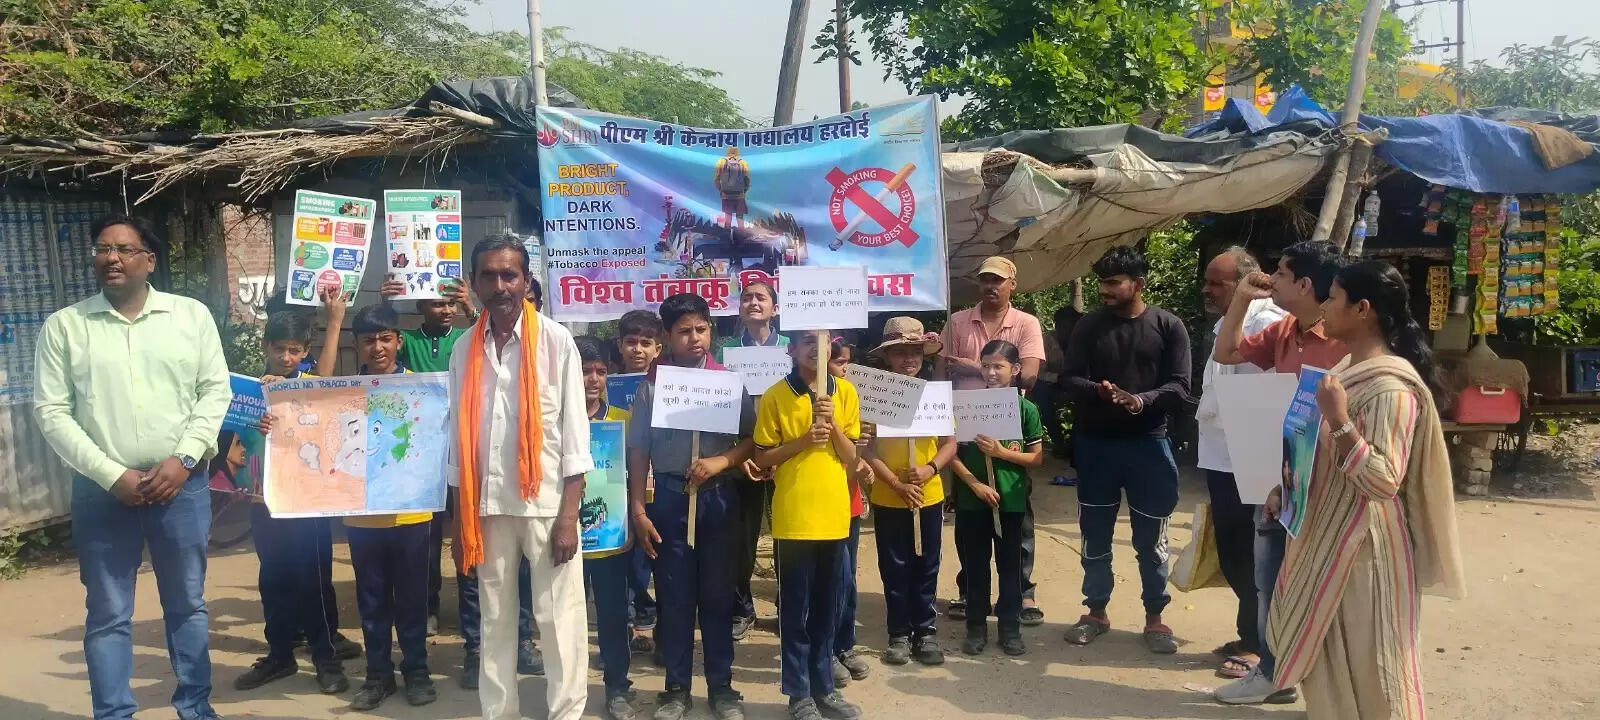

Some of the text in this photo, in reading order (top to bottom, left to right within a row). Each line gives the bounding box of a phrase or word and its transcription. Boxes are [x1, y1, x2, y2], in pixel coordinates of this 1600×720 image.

[600, 121, 648, 144] पीएम
[652, 124, 676, 146] श्री
[819, 112, 871, 142] हरदोई
[558, 163, 618, 178] BRIGHT
[548, 181, 630, 197] PRODUCT,
[832, 170, 877, 215] NOT SMOKING
[567, 200, 613, 214] DARK
[857, 188, 913, 245] YOUR BEST CHOICE!
[545, 217, 641, 232] NTENTIONS.
[547, 246, 646, 257] Unmask the appeal
[547, 258, 646, 269] #Tobacco Exposed
[560, 276, 634, 305] विश्व
[868, 273, 915, 297] वस
[268, 383, 299, 392] WORLD
[303, 381, 314, 389] NO
[233, 392, 266, 407] LAVOUR
[231, 402, 266, 416] HE TRUT
[859, 405, 877, 414] ल्याण
